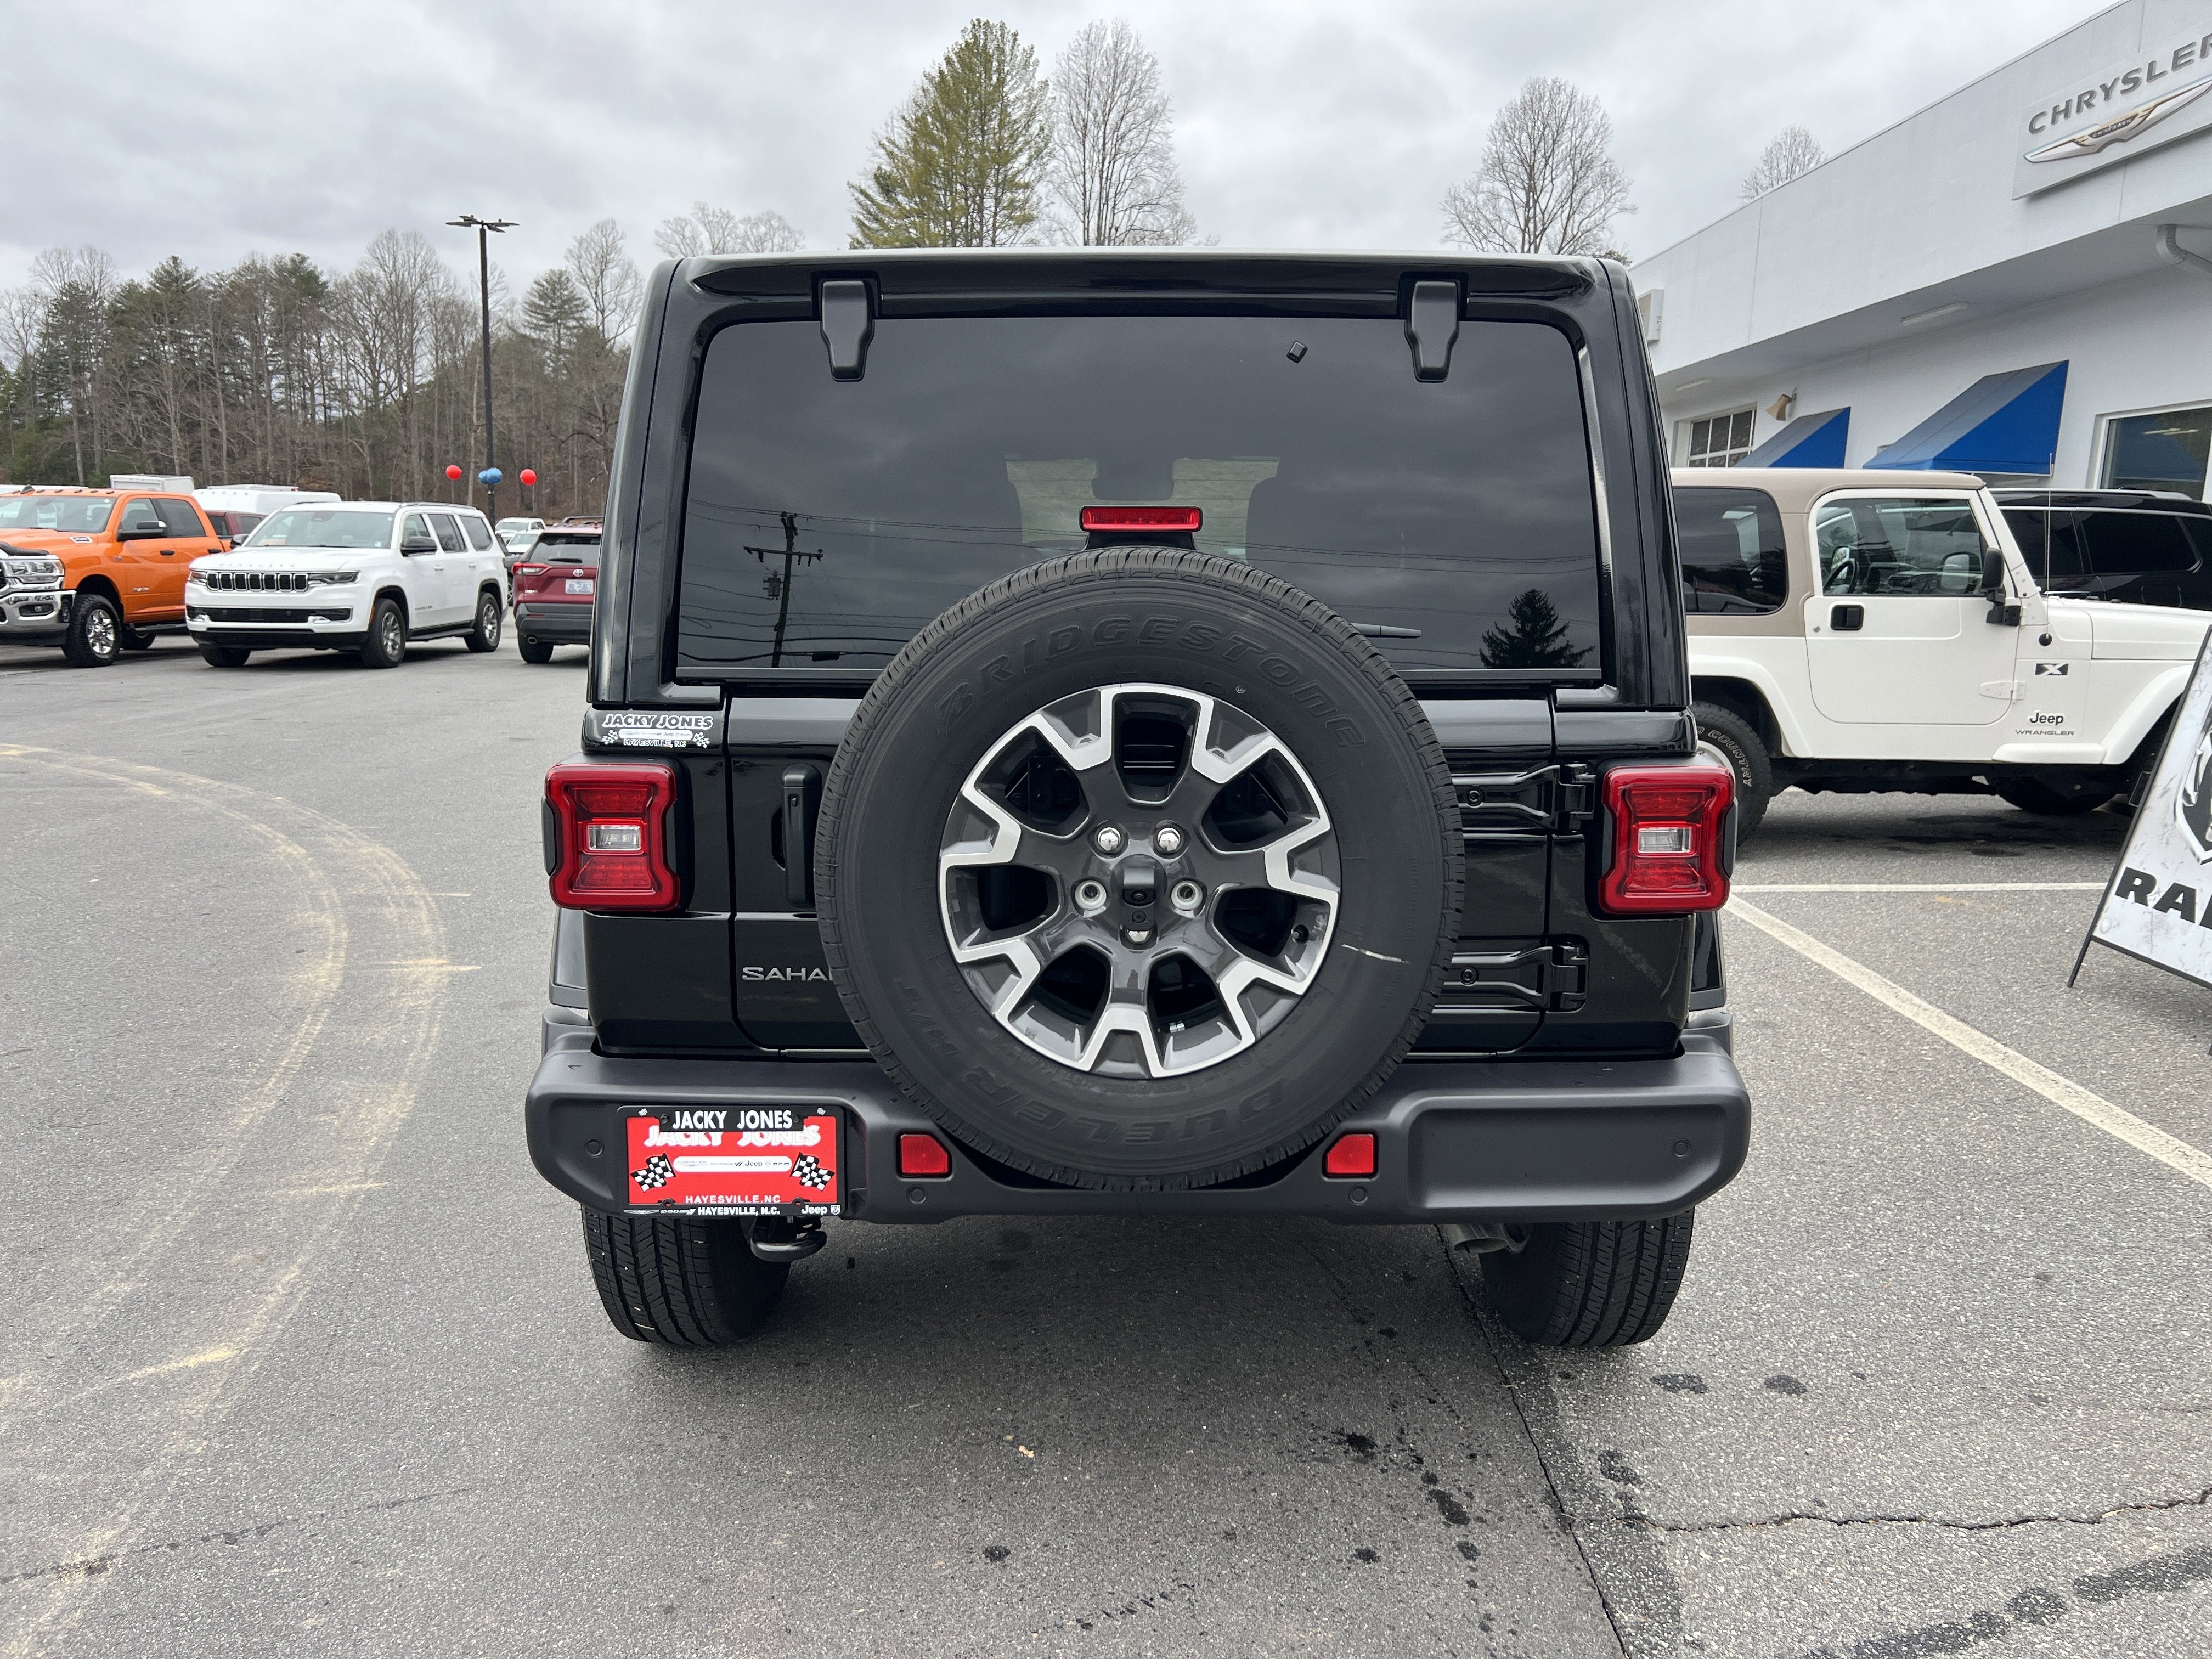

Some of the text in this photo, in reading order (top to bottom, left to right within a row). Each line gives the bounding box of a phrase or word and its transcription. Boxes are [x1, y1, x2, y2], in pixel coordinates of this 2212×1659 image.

[937, 613, 1369, 749] BRIDGESTONE
[602, 714, 714, 730] JACKY JONES
[2028, 712, 2064, 726] Jeep
[1708, 730, 1752, 788] COUNTRY
[2115, 866, 2212, 929] RA
[742, 967, 834, 981] SAHA
[672, 1110, 793, 1130] JACKY JONES
[698, 1207, 759, 1216] HAYESVILLE,
[801, 1205, 828, 1215] Jeep
